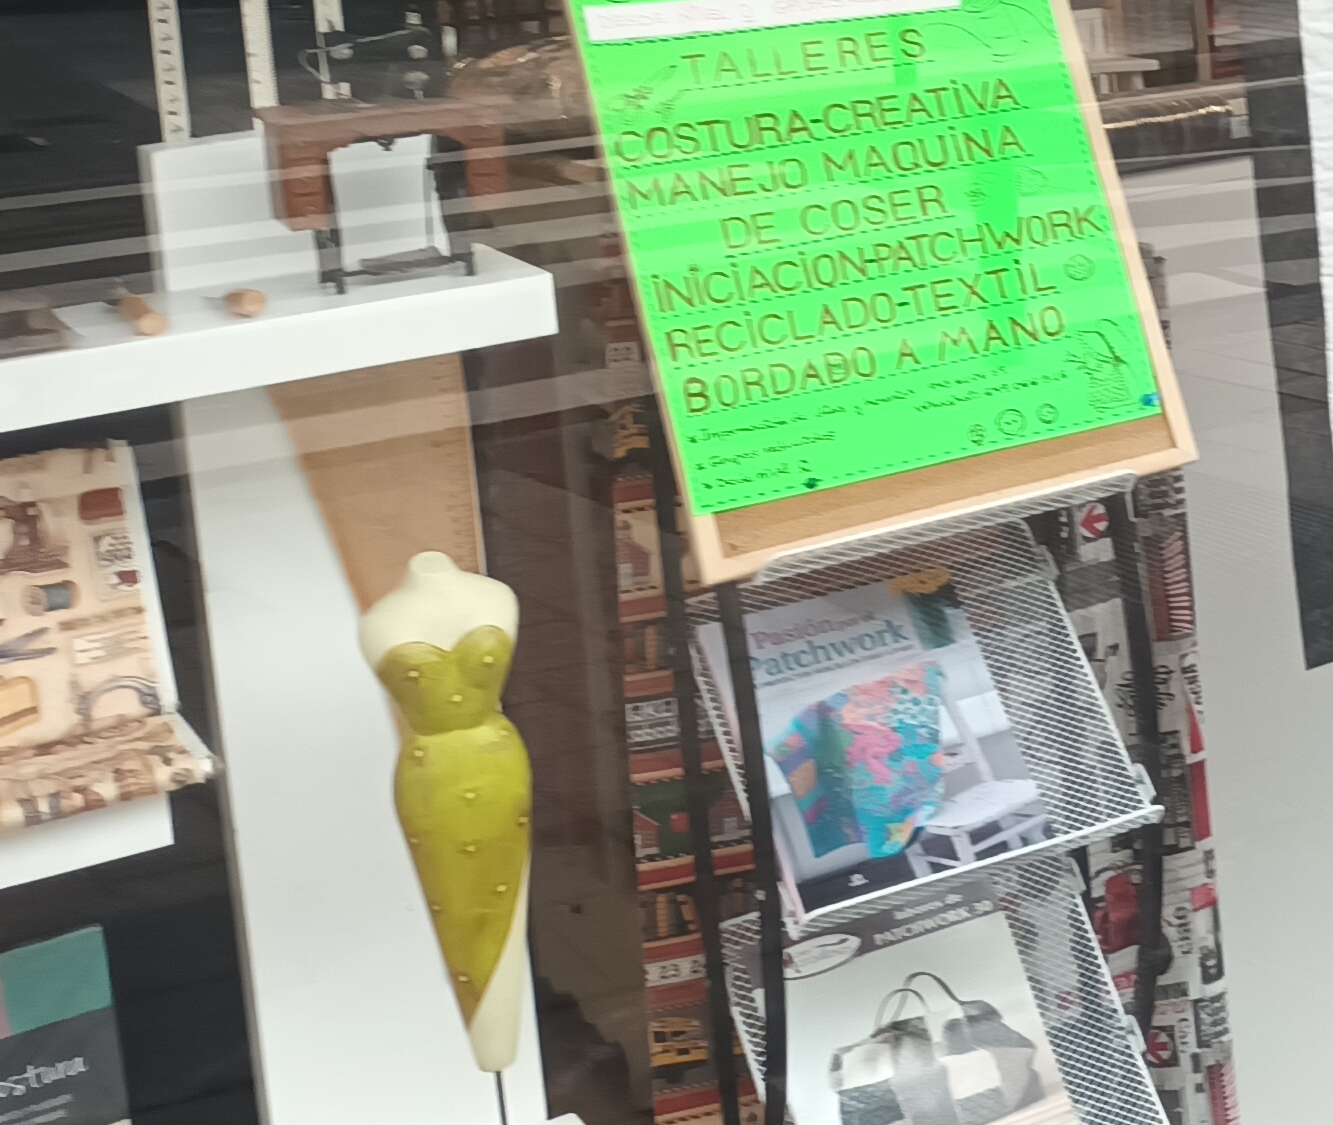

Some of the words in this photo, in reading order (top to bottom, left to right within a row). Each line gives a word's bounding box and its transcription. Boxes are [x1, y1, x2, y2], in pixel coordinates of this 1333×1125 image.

[680, 28, 926, 86] TALLERES
[622, 157, 808, 211] MANEJO
[820, 125, 1027, 183] MAQUINA
[719, 211, 780, 250] DE
[798, 185, 949, 236] COSER
[895, 338, 921, 368] A
[938, 305, 1066, 361] MANO
